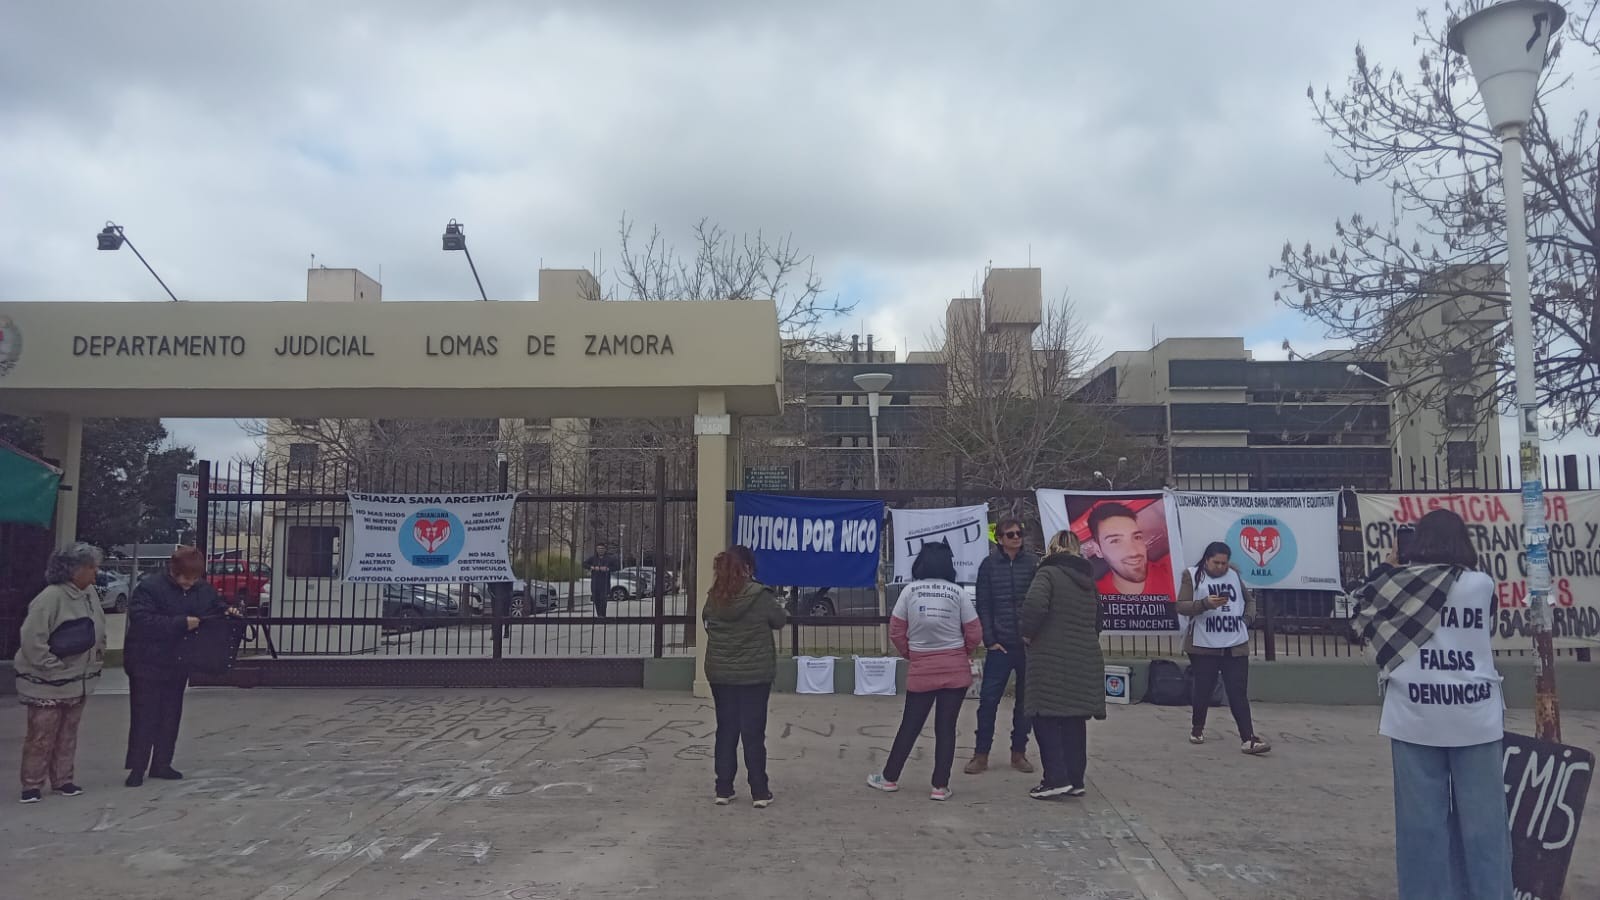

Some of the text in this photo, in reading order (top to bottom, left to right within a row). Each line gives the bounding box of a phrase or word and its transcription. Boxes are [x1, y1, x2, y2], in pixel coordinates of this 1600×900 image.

[73, 334, 674, 356] DEPARTAMENTO JUDICIAL LOMAS DE ZAMORA
[351, 493, 514, 504] CRIANZA SANA ARGENTINA
[736, 515, 798, 551] JUSTICIA
[801, 518, 835, 552] POR
[840, 518, 877, 553] NICO
[1585, 521, 1598, 549] Y
[348, 575, 393, 583] CUSTODIA
[458, 575, 509, 583] EQUITATIVA
[1114, 620, 1126, 629] ES
[1129, 620, 1175, 629] INOCENTE
[1463, 607, 1483, 629] DE
[1420, 649, 1475, 671] FALSAS
[1408, 682, 1492, 705] DENUNCIAS
